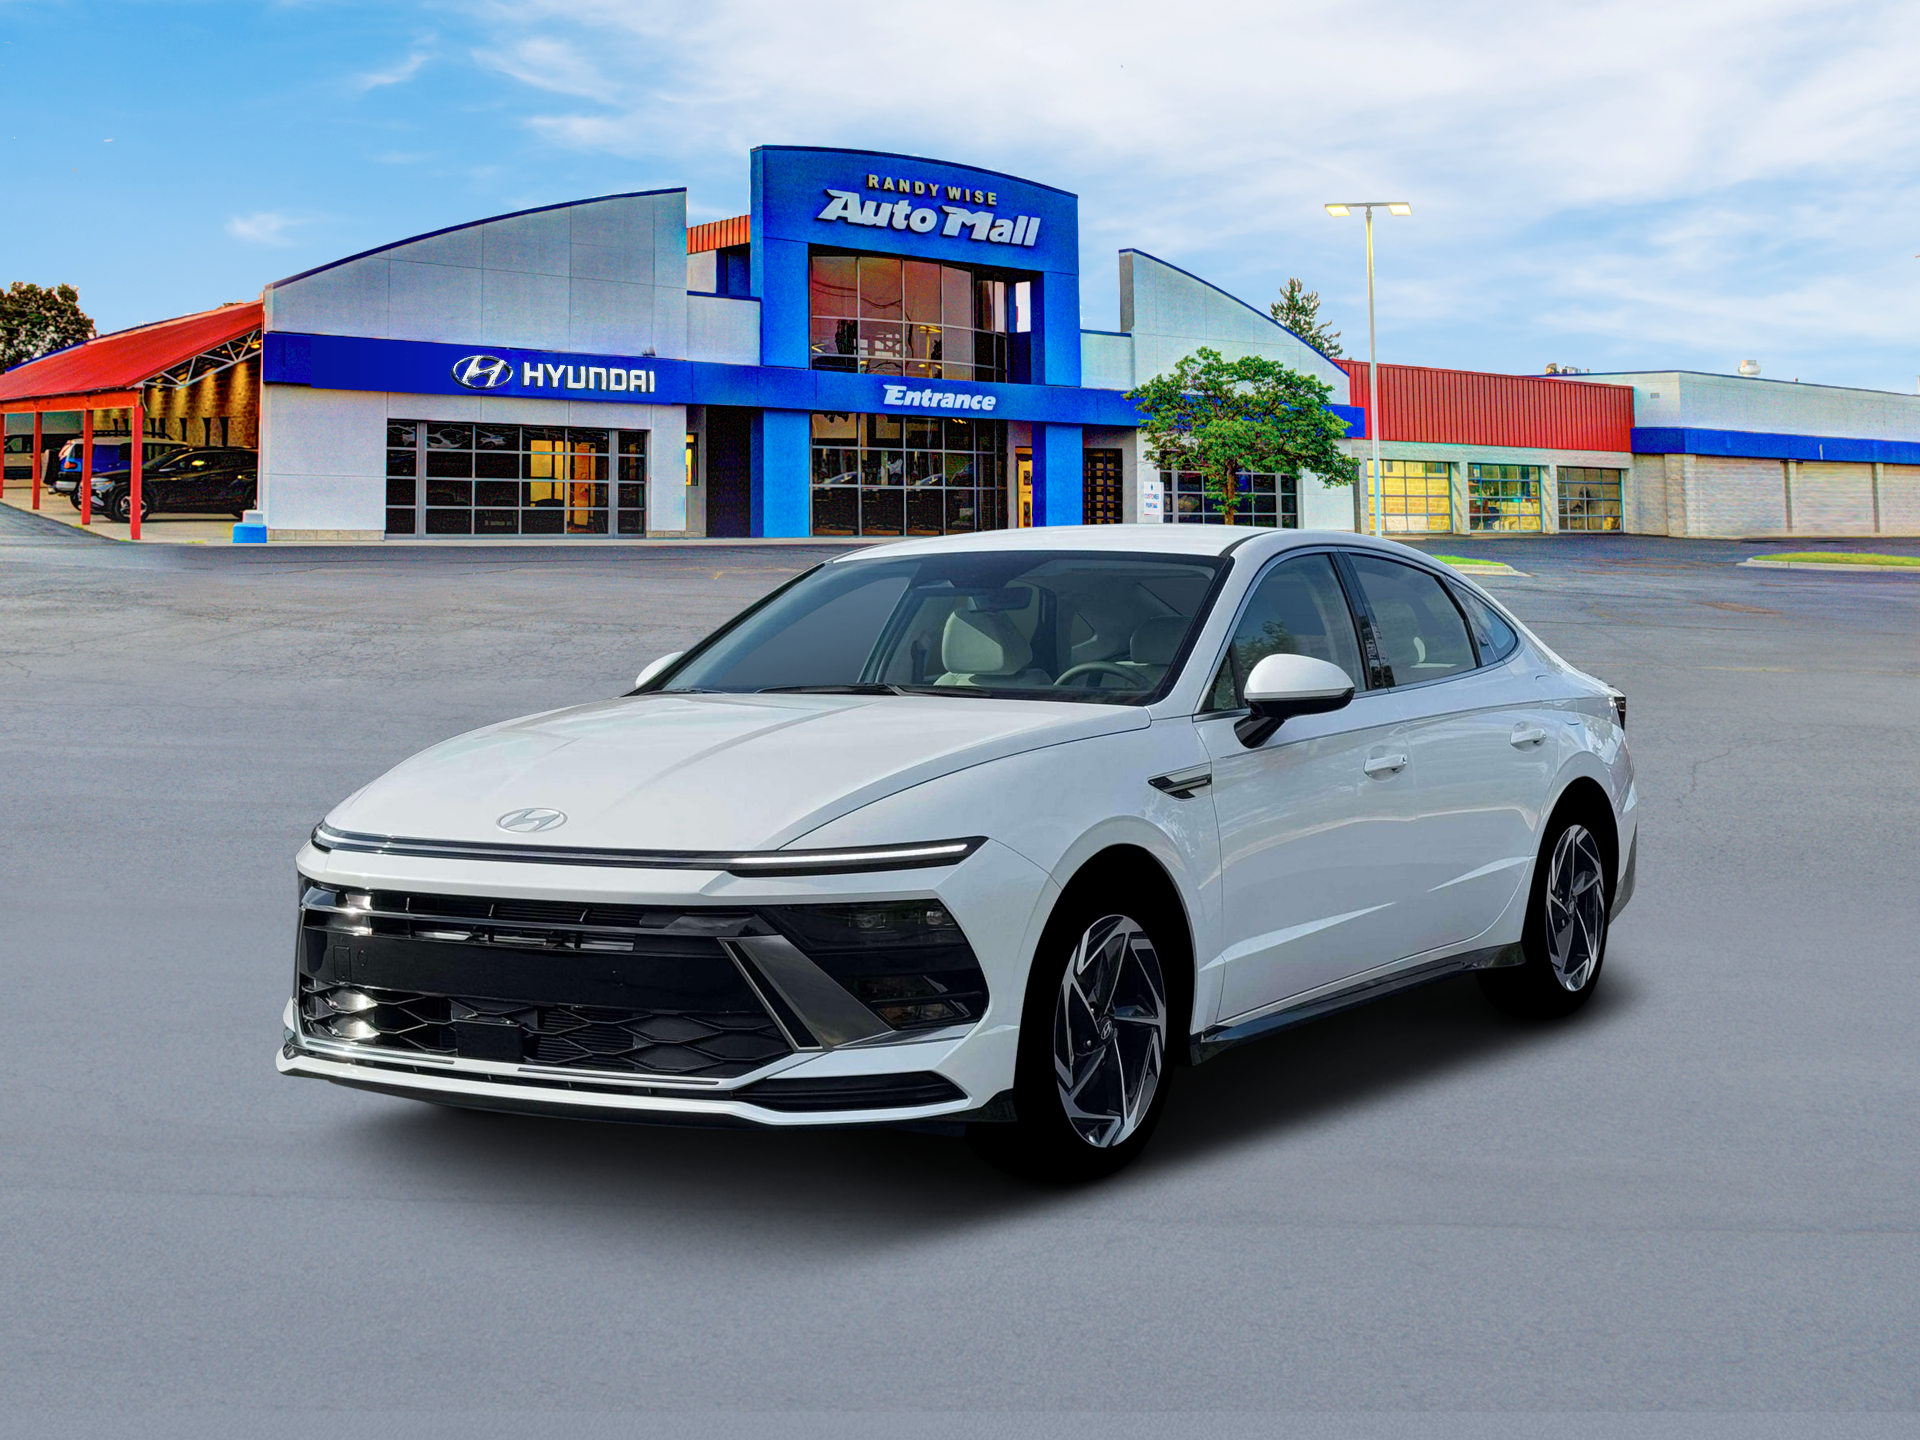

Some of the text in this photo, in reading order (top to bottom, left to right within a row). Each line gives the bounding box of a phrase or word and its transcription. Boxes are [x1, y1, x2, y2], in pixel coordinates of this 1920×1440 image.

[867, 174, 998, 205] RANDY WISE
[817, 188, 1041, 246] Auto Mall
[522, 362, 655, 393] HYUNDAI
[883, 384, 996, 411] Entrance
